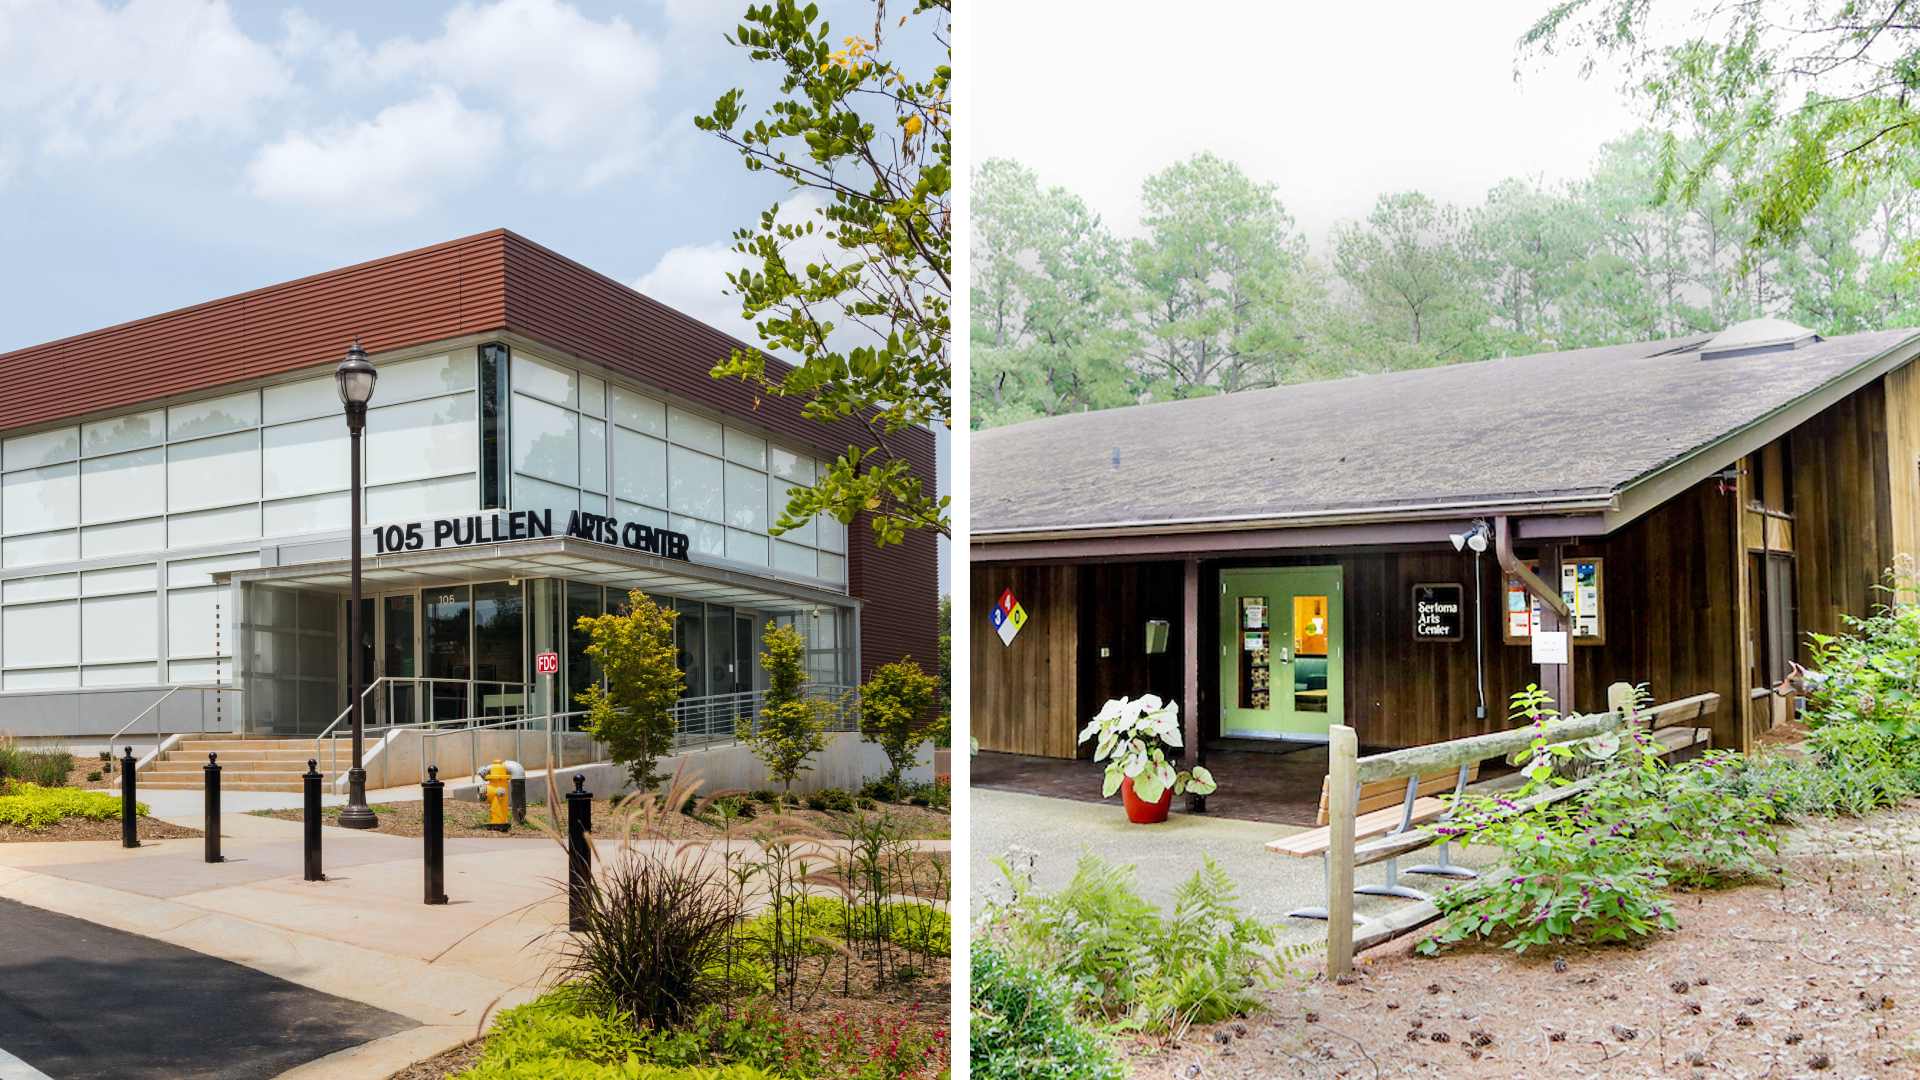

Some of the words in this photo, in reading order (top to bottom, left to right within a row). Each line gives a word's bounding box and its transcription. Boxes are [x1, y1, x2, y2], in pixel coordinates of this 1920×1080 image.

[373, 523, 424, 553] 105
[434, 509, 552, 547] PULLEN
[565, 510, 618, 545] ARTS
[622, 521, 691, 562] CENTER
[438, 595, 456, 605] 105
[1004, 594, 1011, 611] 4
[1418, 601, 1457, 613] Sertoma
[994, 609, 1001, 625] 3
[1418, 614, 1440, 624] Arts
[1418, 624, 1450, 635] Center
[538, 655, 557, 671] FDC
